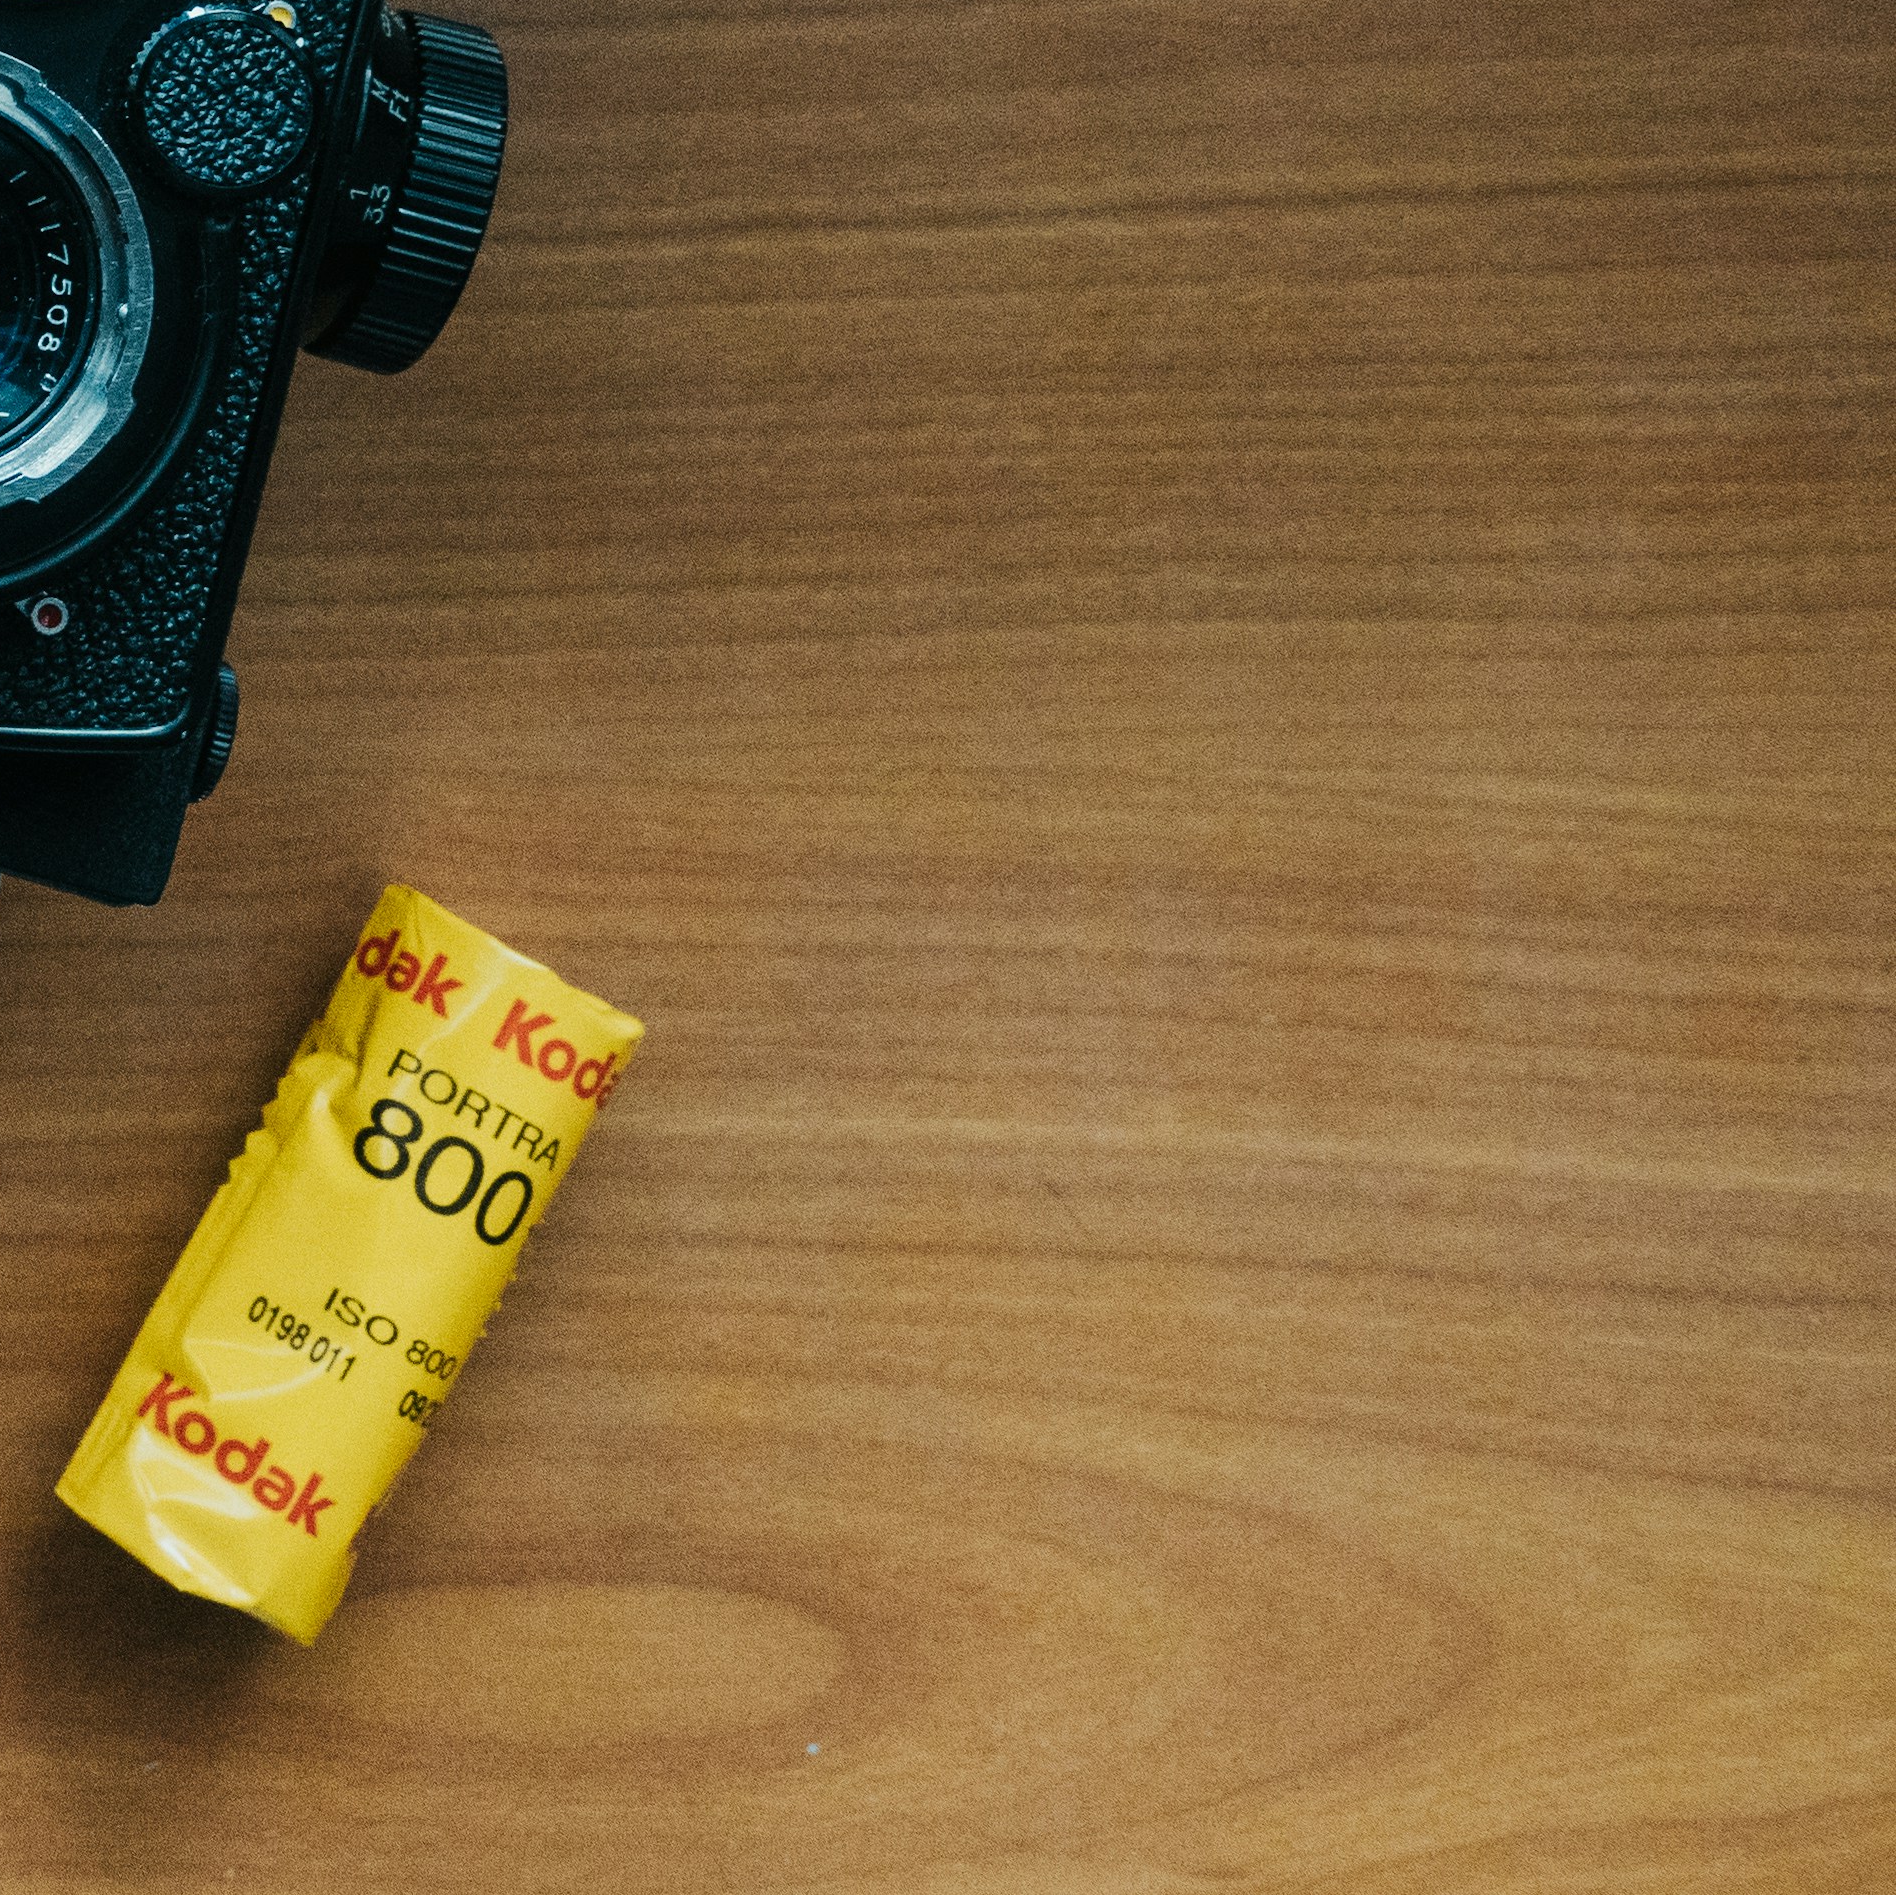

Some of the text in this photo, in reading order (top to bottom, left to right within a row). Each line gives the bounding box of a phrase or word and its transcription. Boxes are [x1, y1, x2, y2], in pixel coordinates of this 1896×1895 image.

[352, 1096, 535, 1246] 800
[385, 1048, 562, 1172] PORTRA
[247, 1295, 311, 1353] 0198
[323, 1286, 457, 1381] ISO 800
[137, 1372, 337, 1539] Kodak
